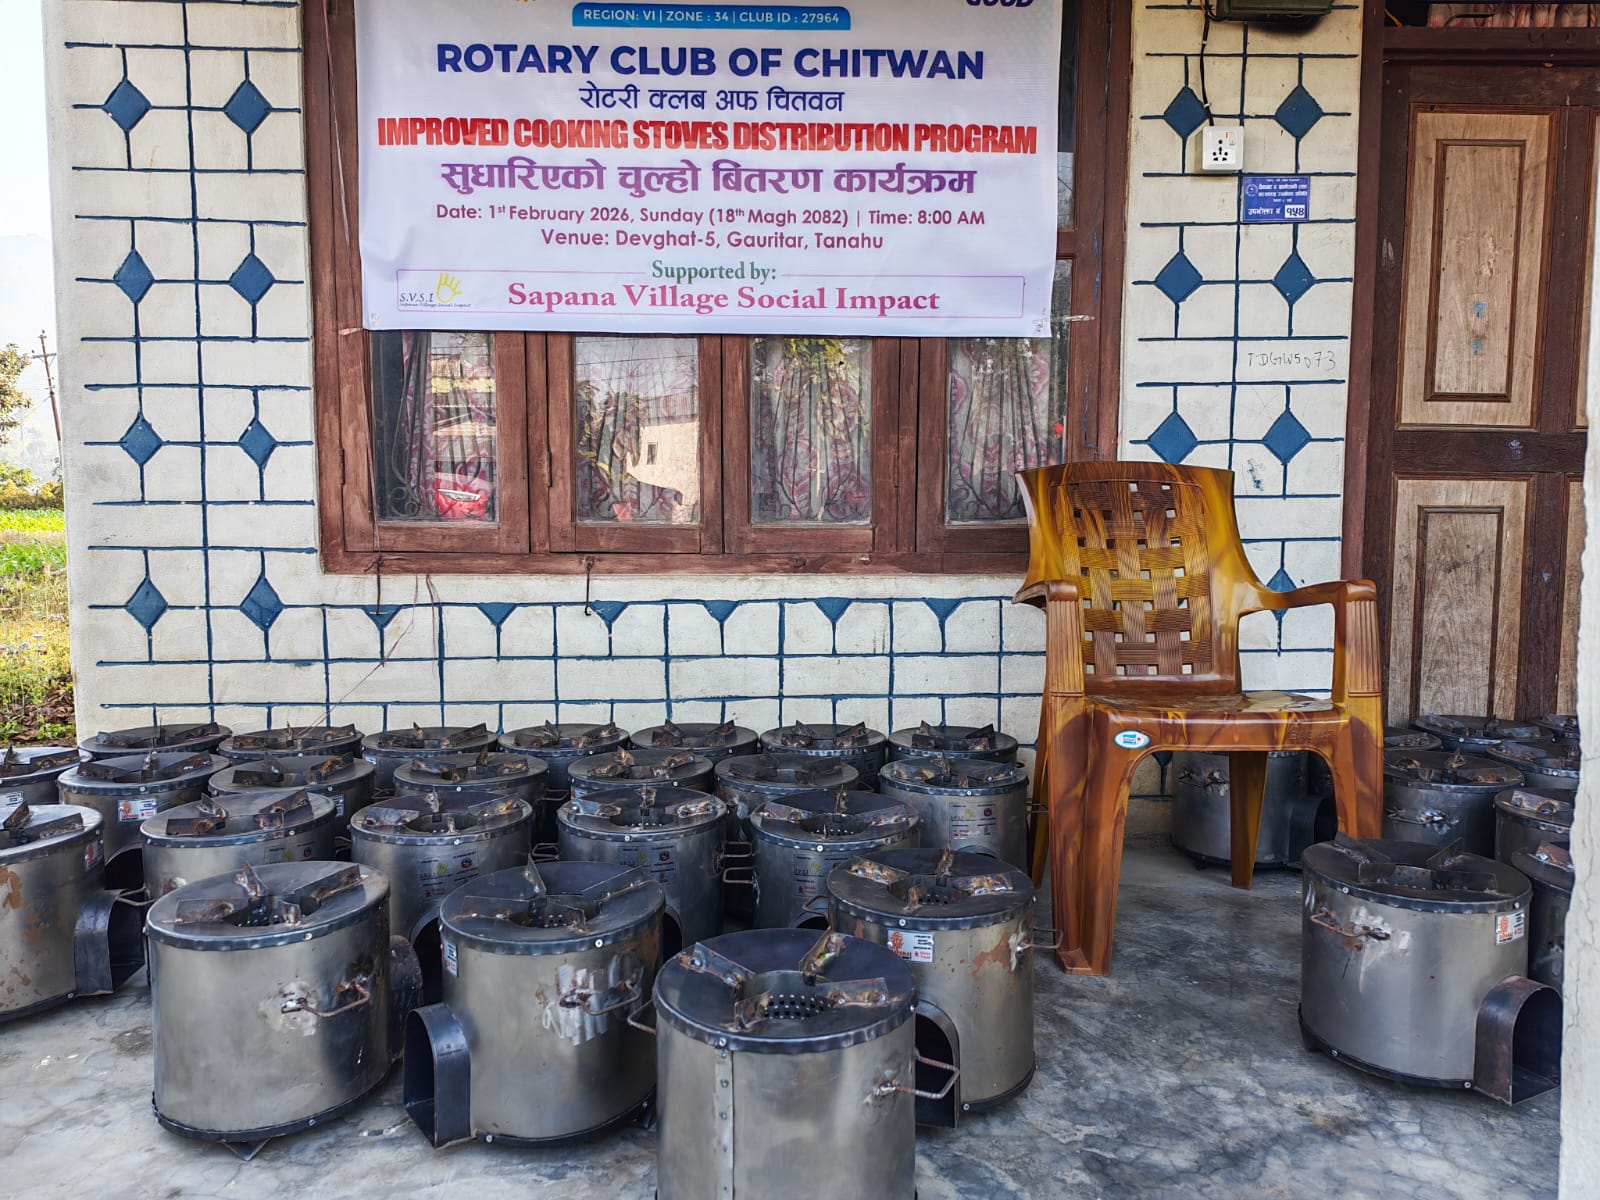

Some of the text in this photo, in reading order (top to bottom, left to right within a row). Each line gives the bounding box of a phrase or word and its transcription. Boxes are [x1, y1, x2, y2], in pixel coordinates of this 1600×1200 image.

[583, 9, 639, 20] REGION:
[643, 10, 655, 20] VI
[666, 11, 703, 21] ZONE
[714, 12, 728, 22] 34
[739, 12, 774, 22] CLUB
[777, 13, 791, 23] ID
[801, 13, 839, 23] 27964
[437, 43, 983, 79] ROTARY CLUB OF CHITWAN
[578, 81, 845, 112] रोटरी क्लब अफ चितवन
[377, 117, 1037, 154] IMPROVED COOKING STOVES DISTRIBUTION PROGRAM
[441, 156, 978, 198] सुधारिएको चुल्हो बितरण कार्यक्रम
[437, 204, 482, 219] Date:
[510, 206, 585, 224] February
[590, 207, 635, 223] 2026,
[640, 208, 703, 226] Sunday
[709, 208, 745, 226] (18th
[748, 209, 797, 227] Magh
[802, 209, 848, 228] 2082)
[869, 210, 913, 224] Time:
[918, 210, 952, 225] 8:00
[957, 211, 986, 225] AM
[541, 229, 883, 250] Venue: Devghat-5, Gauritar, Tanahu
[652, 260, 776, 285] Supported by:
[508, 283, 940, 317] Sapana Village Social Impact
